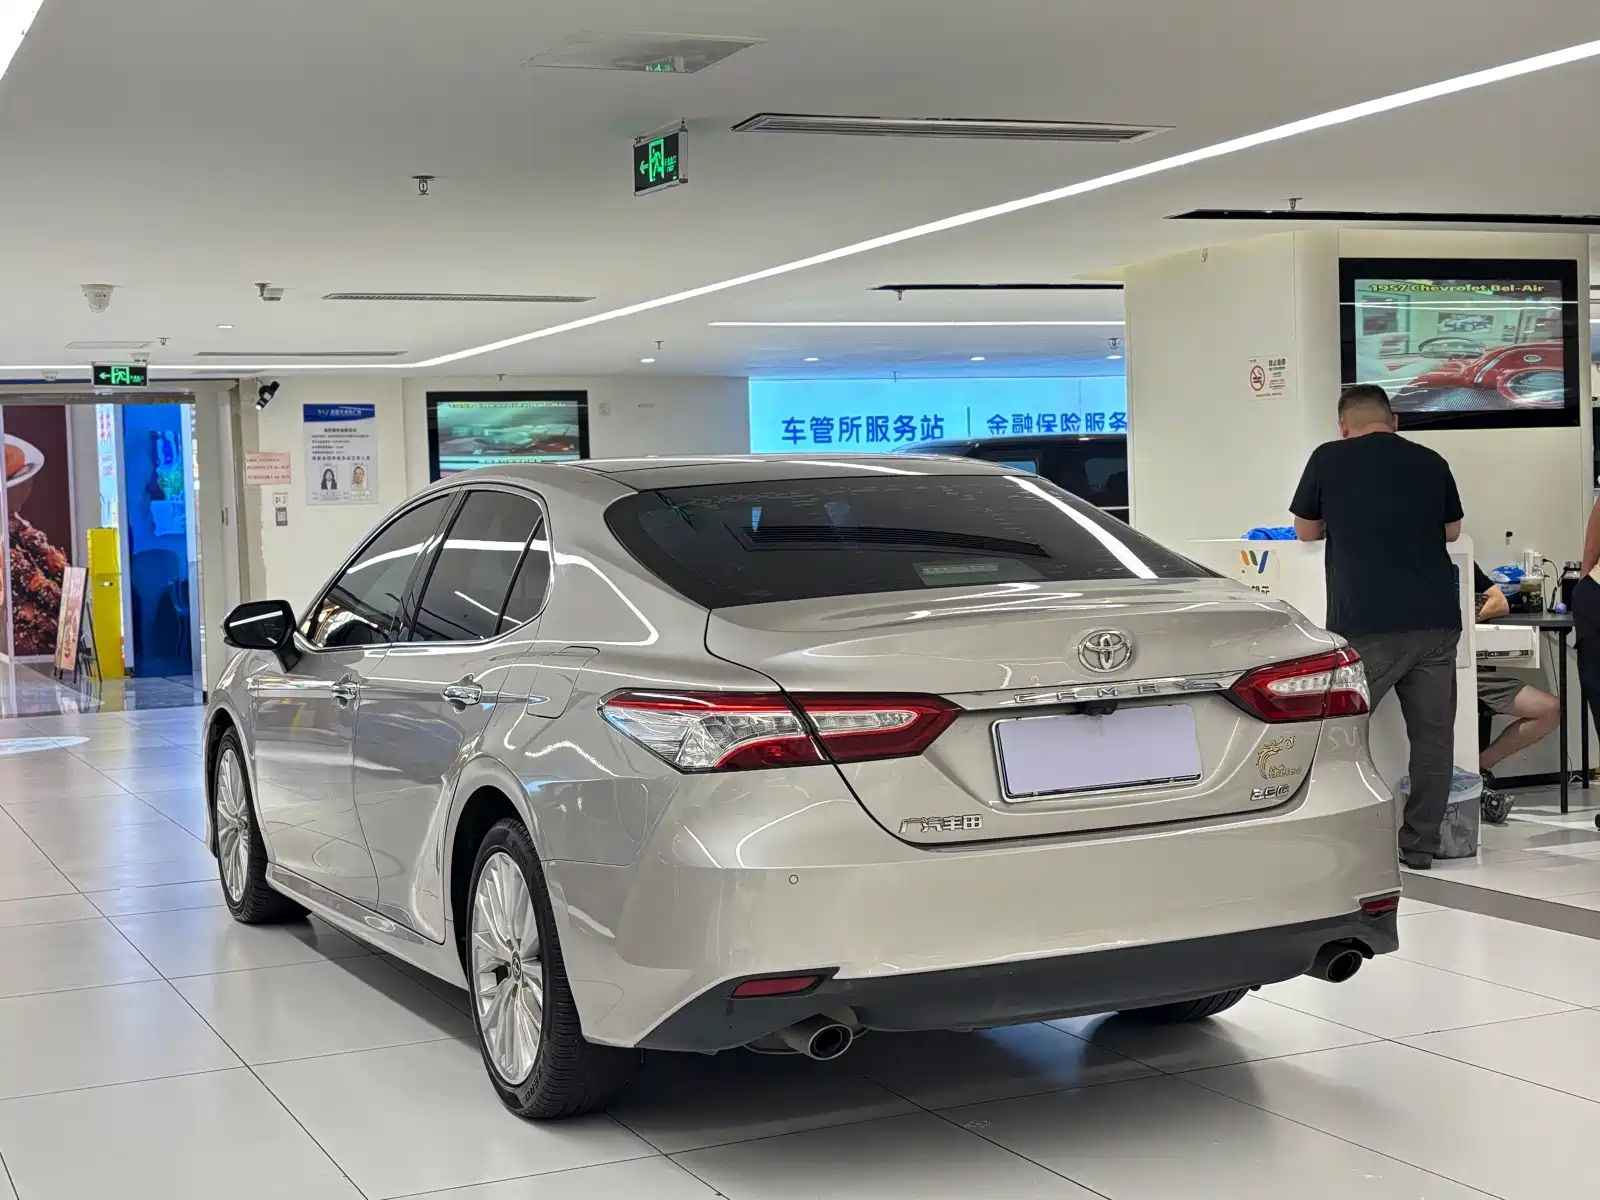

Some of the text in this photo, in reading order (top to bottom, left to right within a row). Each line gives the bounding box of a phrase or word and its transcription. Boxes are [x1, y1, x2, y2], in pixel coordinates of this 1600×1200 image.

[1369, 283, 1545, 292] 1957 Chevrolet Bel-Air
[781, 412, 1127, 445] 车管所服务站 金融保险服务
[1014, 683, 1197, 704] CAMRY
[899, 813, 983, 834] 广汽丰田
